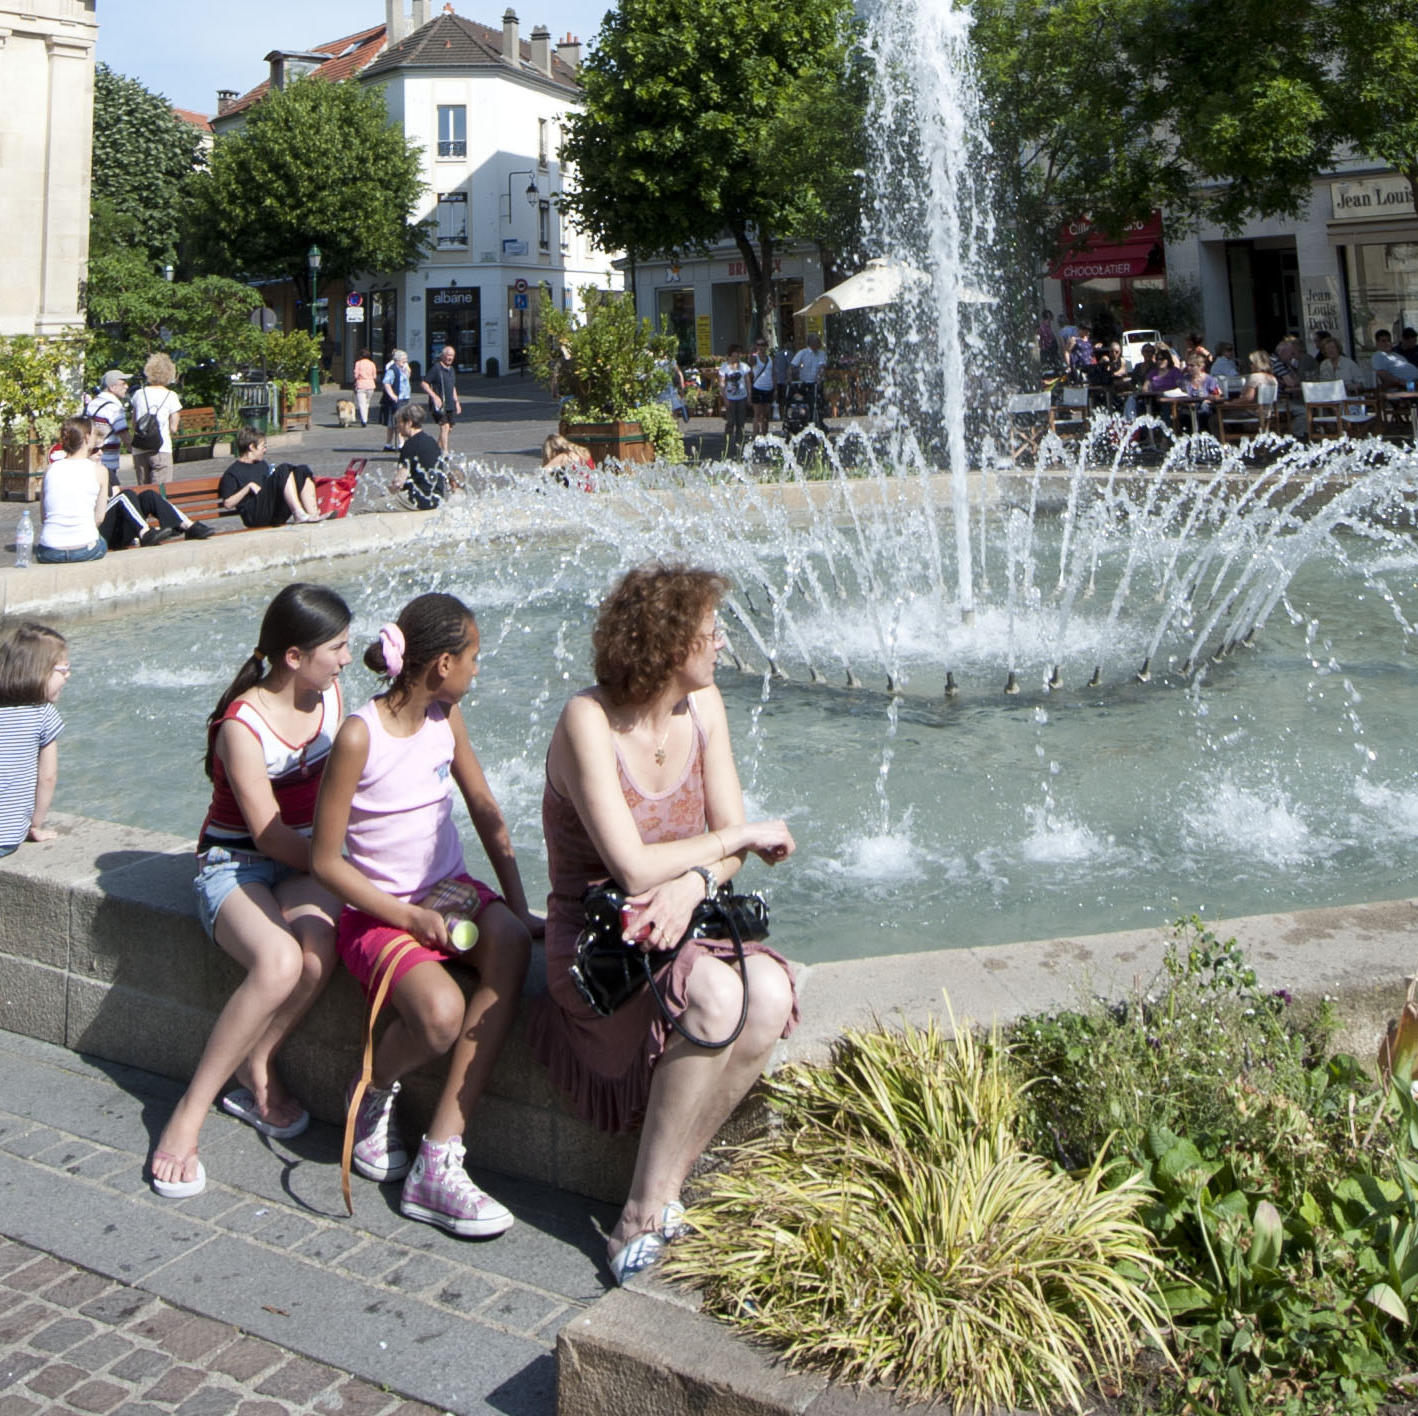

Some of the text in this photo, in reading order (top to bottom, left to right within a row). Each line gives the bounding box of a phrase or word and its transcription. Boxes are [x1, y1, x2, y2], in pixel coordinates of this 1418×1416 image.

[1337, 192, 1372, 209] Jean
[1375, 186, 1414, 206] Louis
[1064, 264, 1131, 277] CHOCOLATIER
[433, 290, 473, 304] albane
[1306, 289, 1331, 301] Jean
[1308, 303, 1336, 316] Louis
[1309, 317, 1339, 330] David
